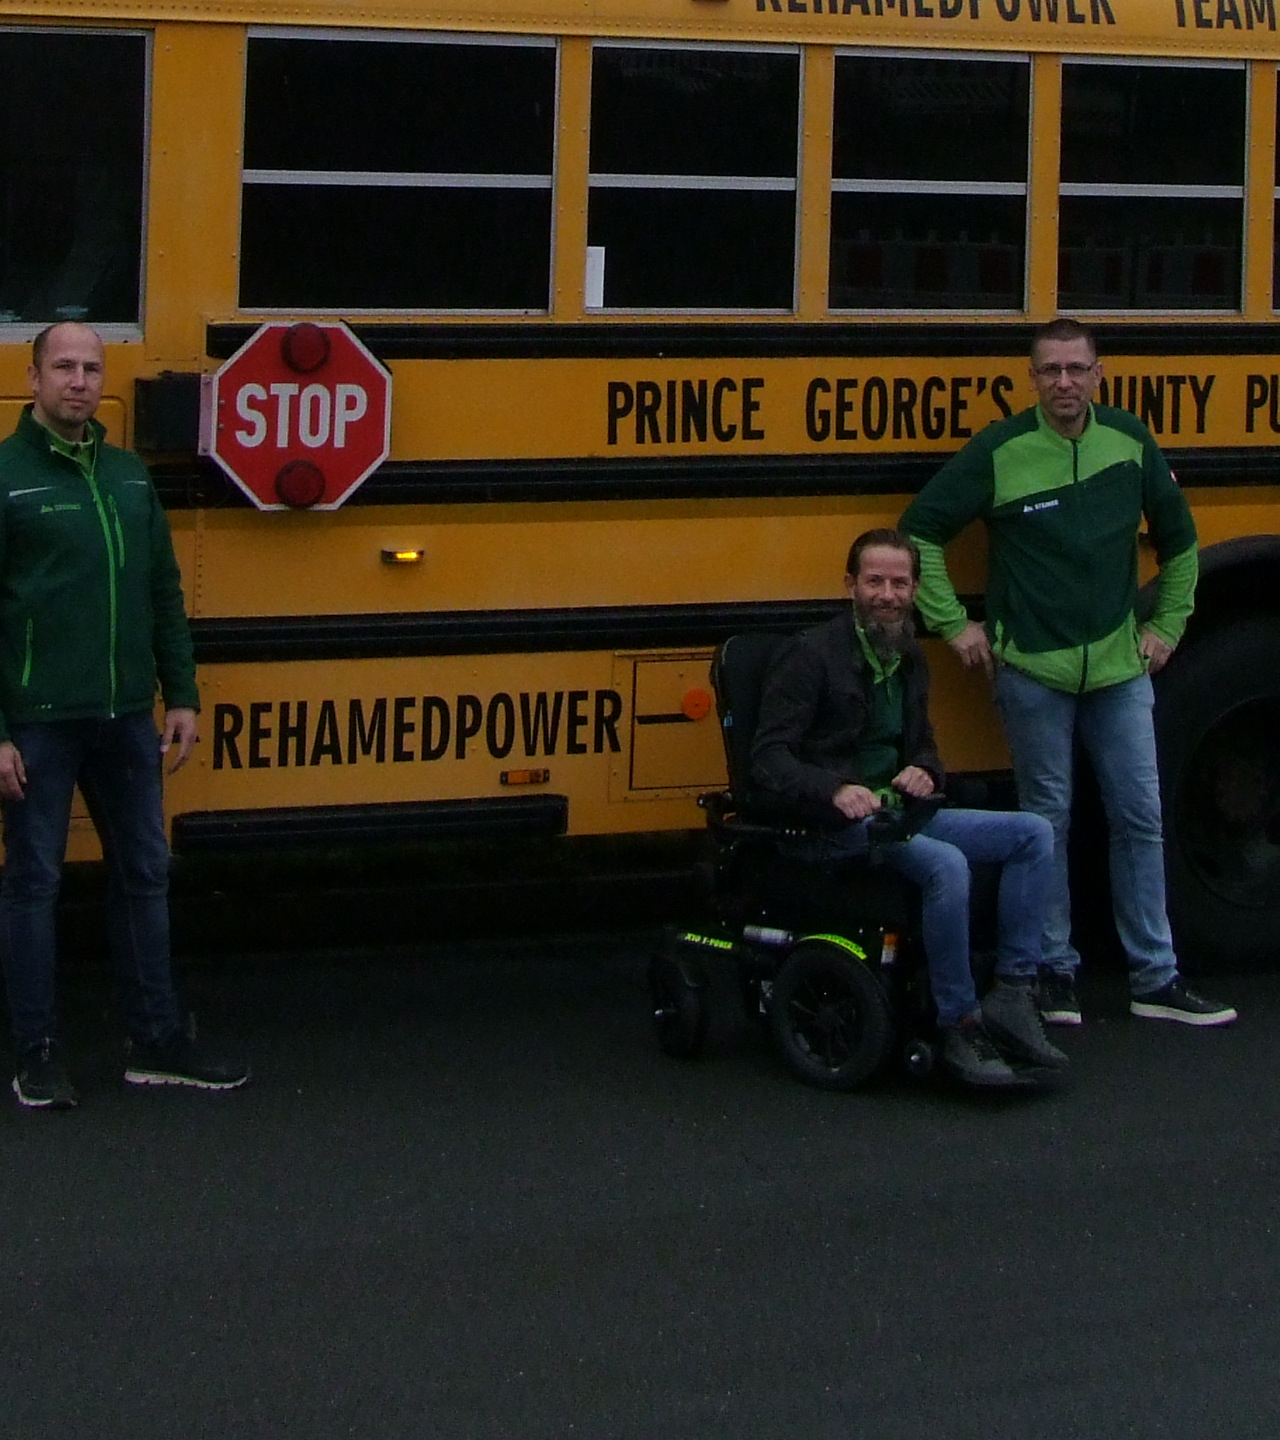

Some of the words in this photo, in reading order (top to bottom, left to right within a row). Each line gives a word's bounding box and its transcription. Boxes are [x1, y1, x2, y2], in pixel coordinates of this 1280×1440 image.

[235, 382, 368, 449] STOP
[606, 376, 766, 445] PRINCE
[805, 374, 1014, 441] GEORGE'S
[212, 688, 622, 771] REHAMEDPOWER
